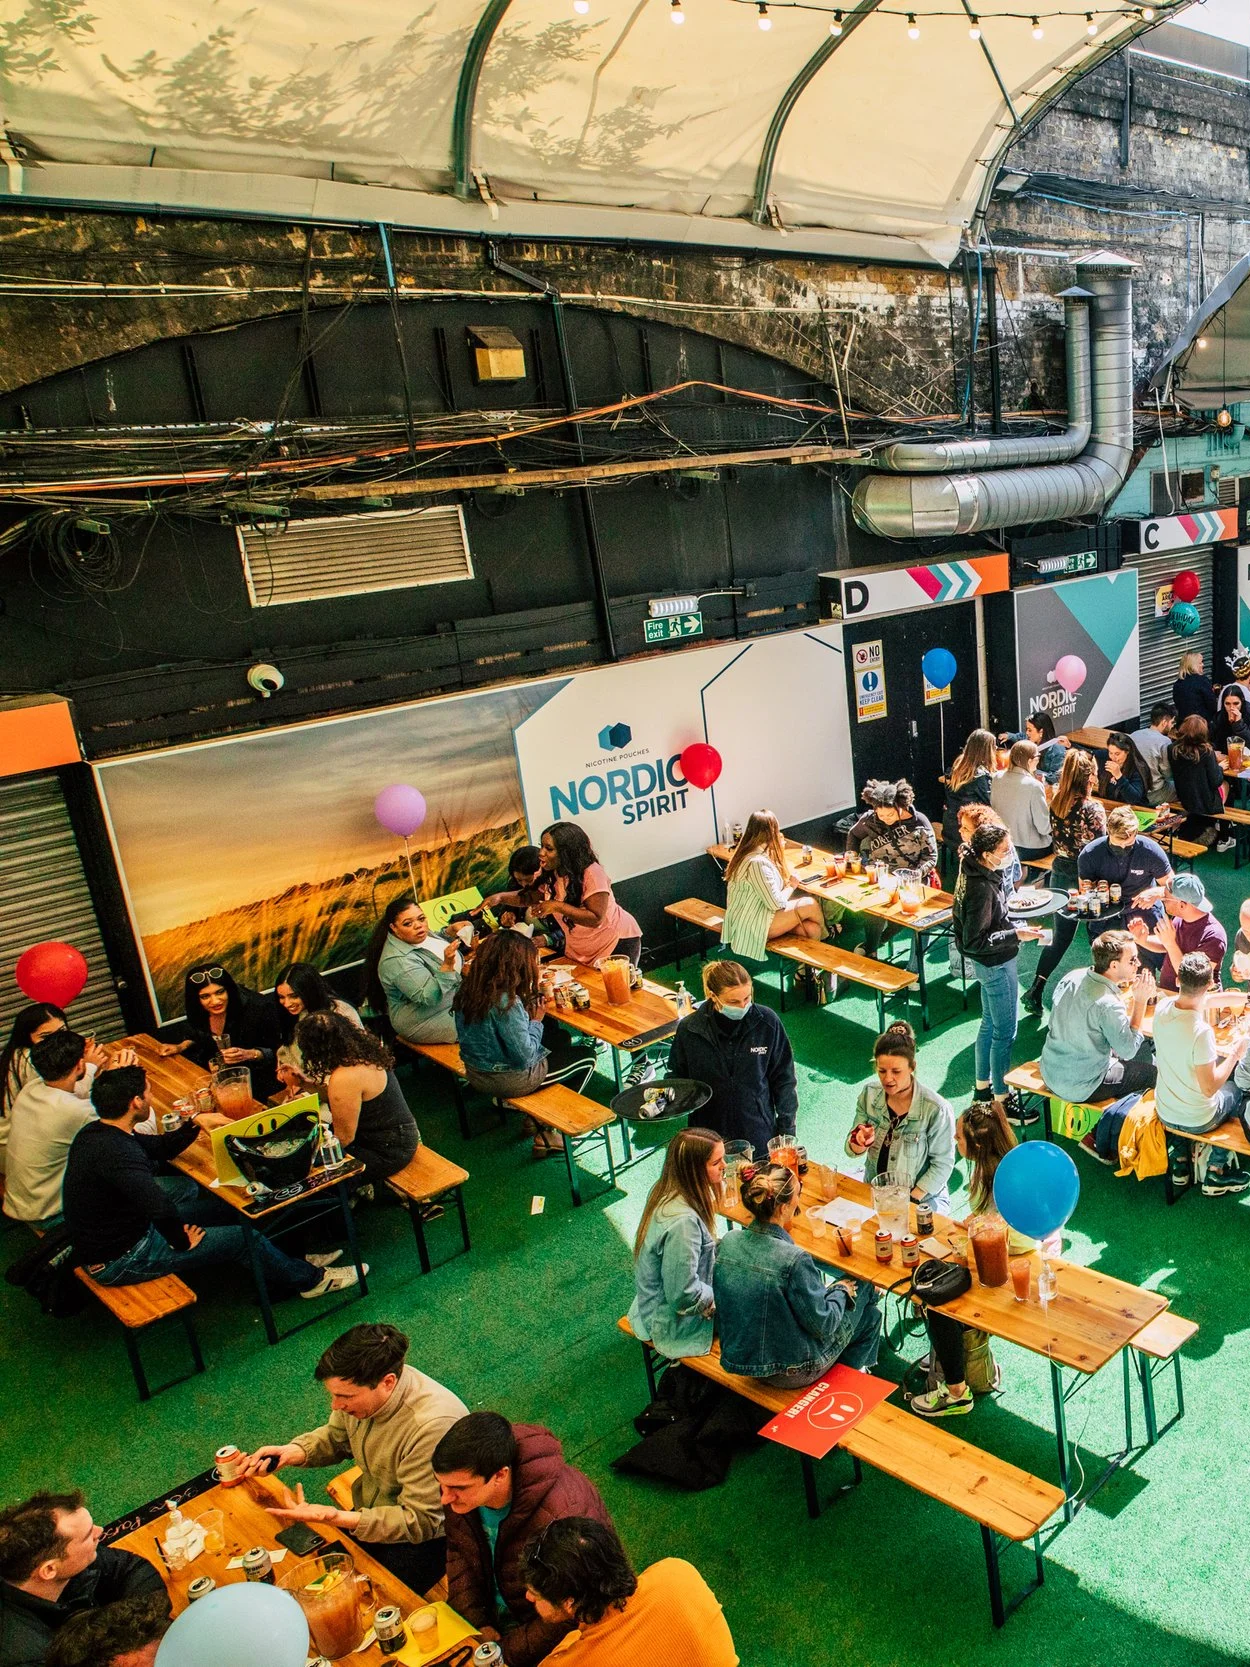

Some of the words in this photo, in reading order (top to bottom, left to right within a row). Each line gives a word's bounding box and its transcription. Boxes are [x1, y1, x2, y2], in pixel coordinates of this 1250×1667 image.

[1144, 523, 1160, 550] C
[845, 580, 869, 615] D
[647, 622, 663, 631] Fire
[648, 630, 664, 639] exit
[868, 645, 880, 658] NO
[859, 698, 871, 706] KEEP
[871, 695, 884, 704] CLEAR
[1030, 689, 1077, 714] NORDIC
[1052, 702, 1077, 719] SPIRIT
[585, 755, 618, 769] NICOTINE
[619, 748, 650, 761] POUCHES
[549, 753, 689, 821] NORDIC
[622, 788, 689, 825] SPIRIT
[784, 1381, 830, 1419] CLANGER!
